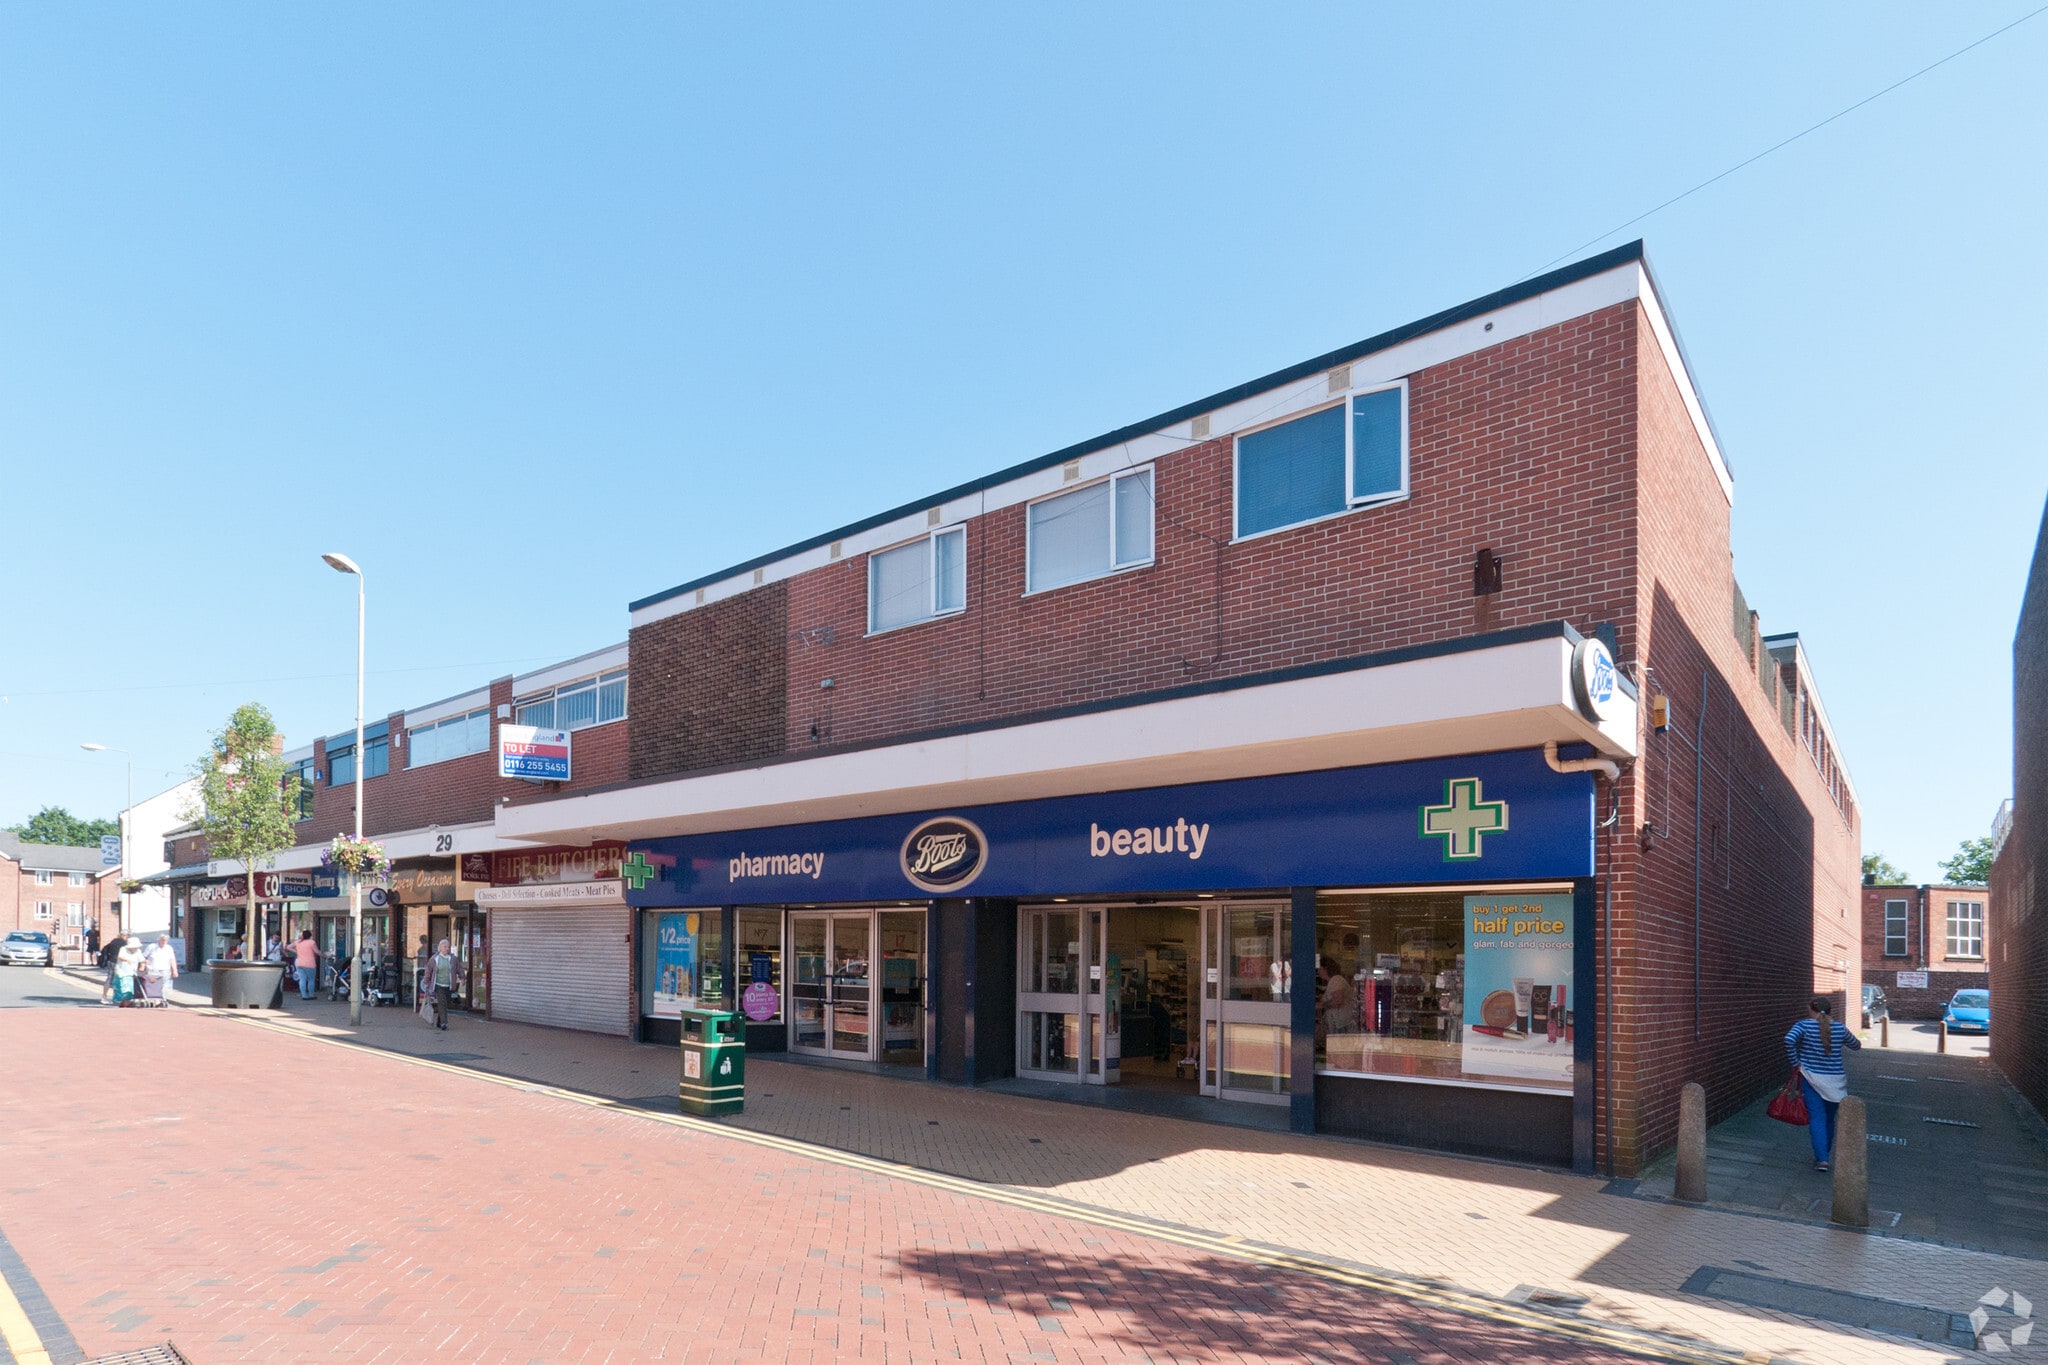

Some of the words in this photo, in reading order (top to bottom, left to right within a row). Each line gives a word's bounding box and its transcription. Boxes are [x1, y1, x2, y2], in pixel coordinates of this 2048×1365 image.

[505, 743, 517, 752] TO
[519, 745, 536, 754] LET
[505, 759, 525, 769] 0116
[527, 761, 543, 770] 255
[545, 762, 566, 772] 5455
[436, 834, 452, 852] 29
[1090, 817, 1209, 859] beauty
[910, 832, 967, 875] Boots
[729, 851, 824, 883] pharmacy
[585, 886, 601, 896] Meat
[602, 885, 615, 896] Pies
[1473, 905, 1490, 915] buy
[1494, 904, 1498, 913] 1
[1502, 904, 1518, 915] get
[1522, 904, 1542, 913] 2nd
[1473, 917, 1509, 933] half
[1514, 917, 1565, 937] price
[661, 927, 676, 944] 1/2
[1473, 940, 1497, 950] glam,
[1500, 940, 1514, 948] fab
[745, 992, 755, 1002] 10
